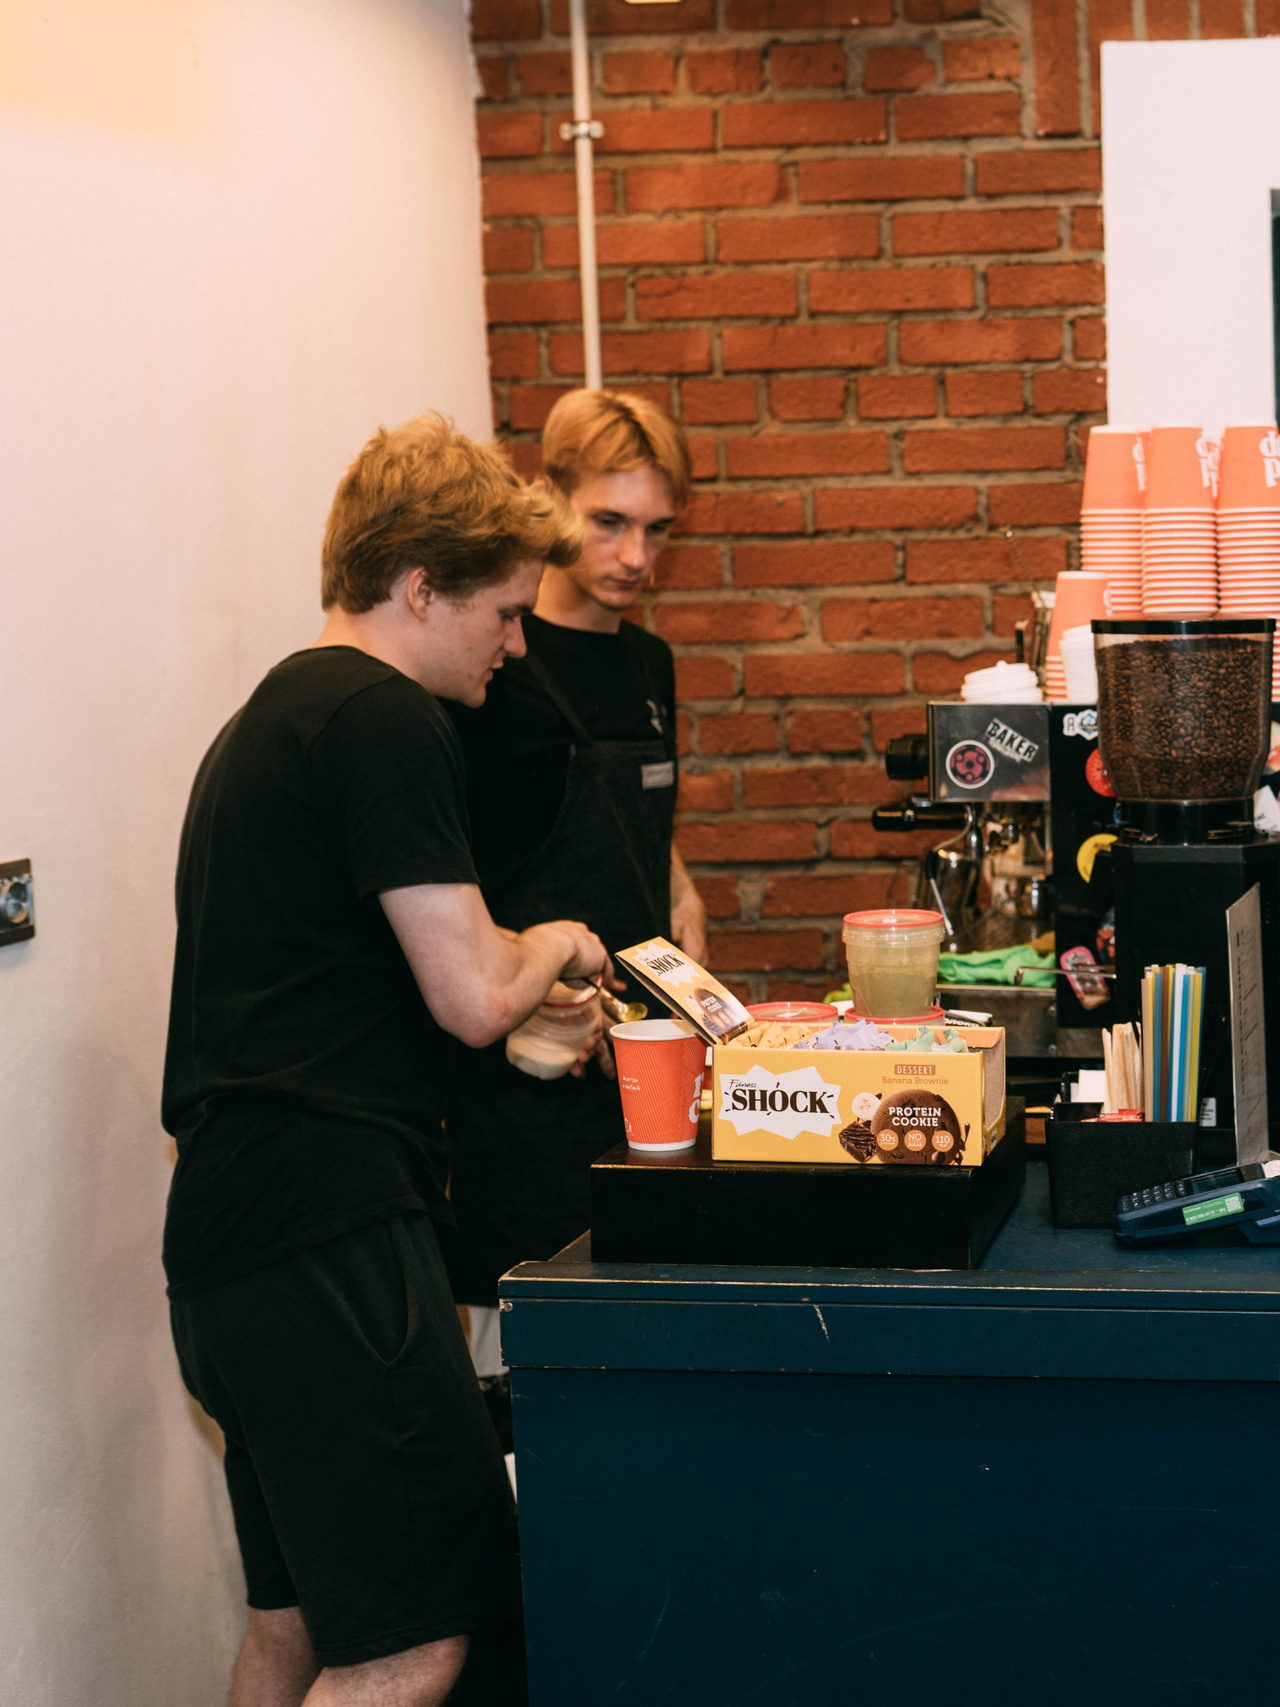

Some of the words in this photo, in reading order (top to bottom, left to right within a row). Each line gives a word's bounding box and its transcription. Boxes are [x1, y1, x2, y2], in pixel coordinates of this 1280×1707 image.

[987, 722, 1036, 761] BAKER
[646, 954, 685, 975] SHOCK
[897, 1065, 933, 1075] DESSERT
[729, 1079, 757, 1089] Fitness
[882, 1076, 913, 1085] Banana
[914, 1077, 949, 1085] Brownie
[731, 1088, 830, 1114] SHOCK
[888, 1107, 942, 1117] PROTEIN
[892, 1117, 939, 1127] COOKIE
[880, 1133, 896, 1142] 30%
[908, 1133, 922, 1141] NO
[935, 1135, 950, 1144] 110
